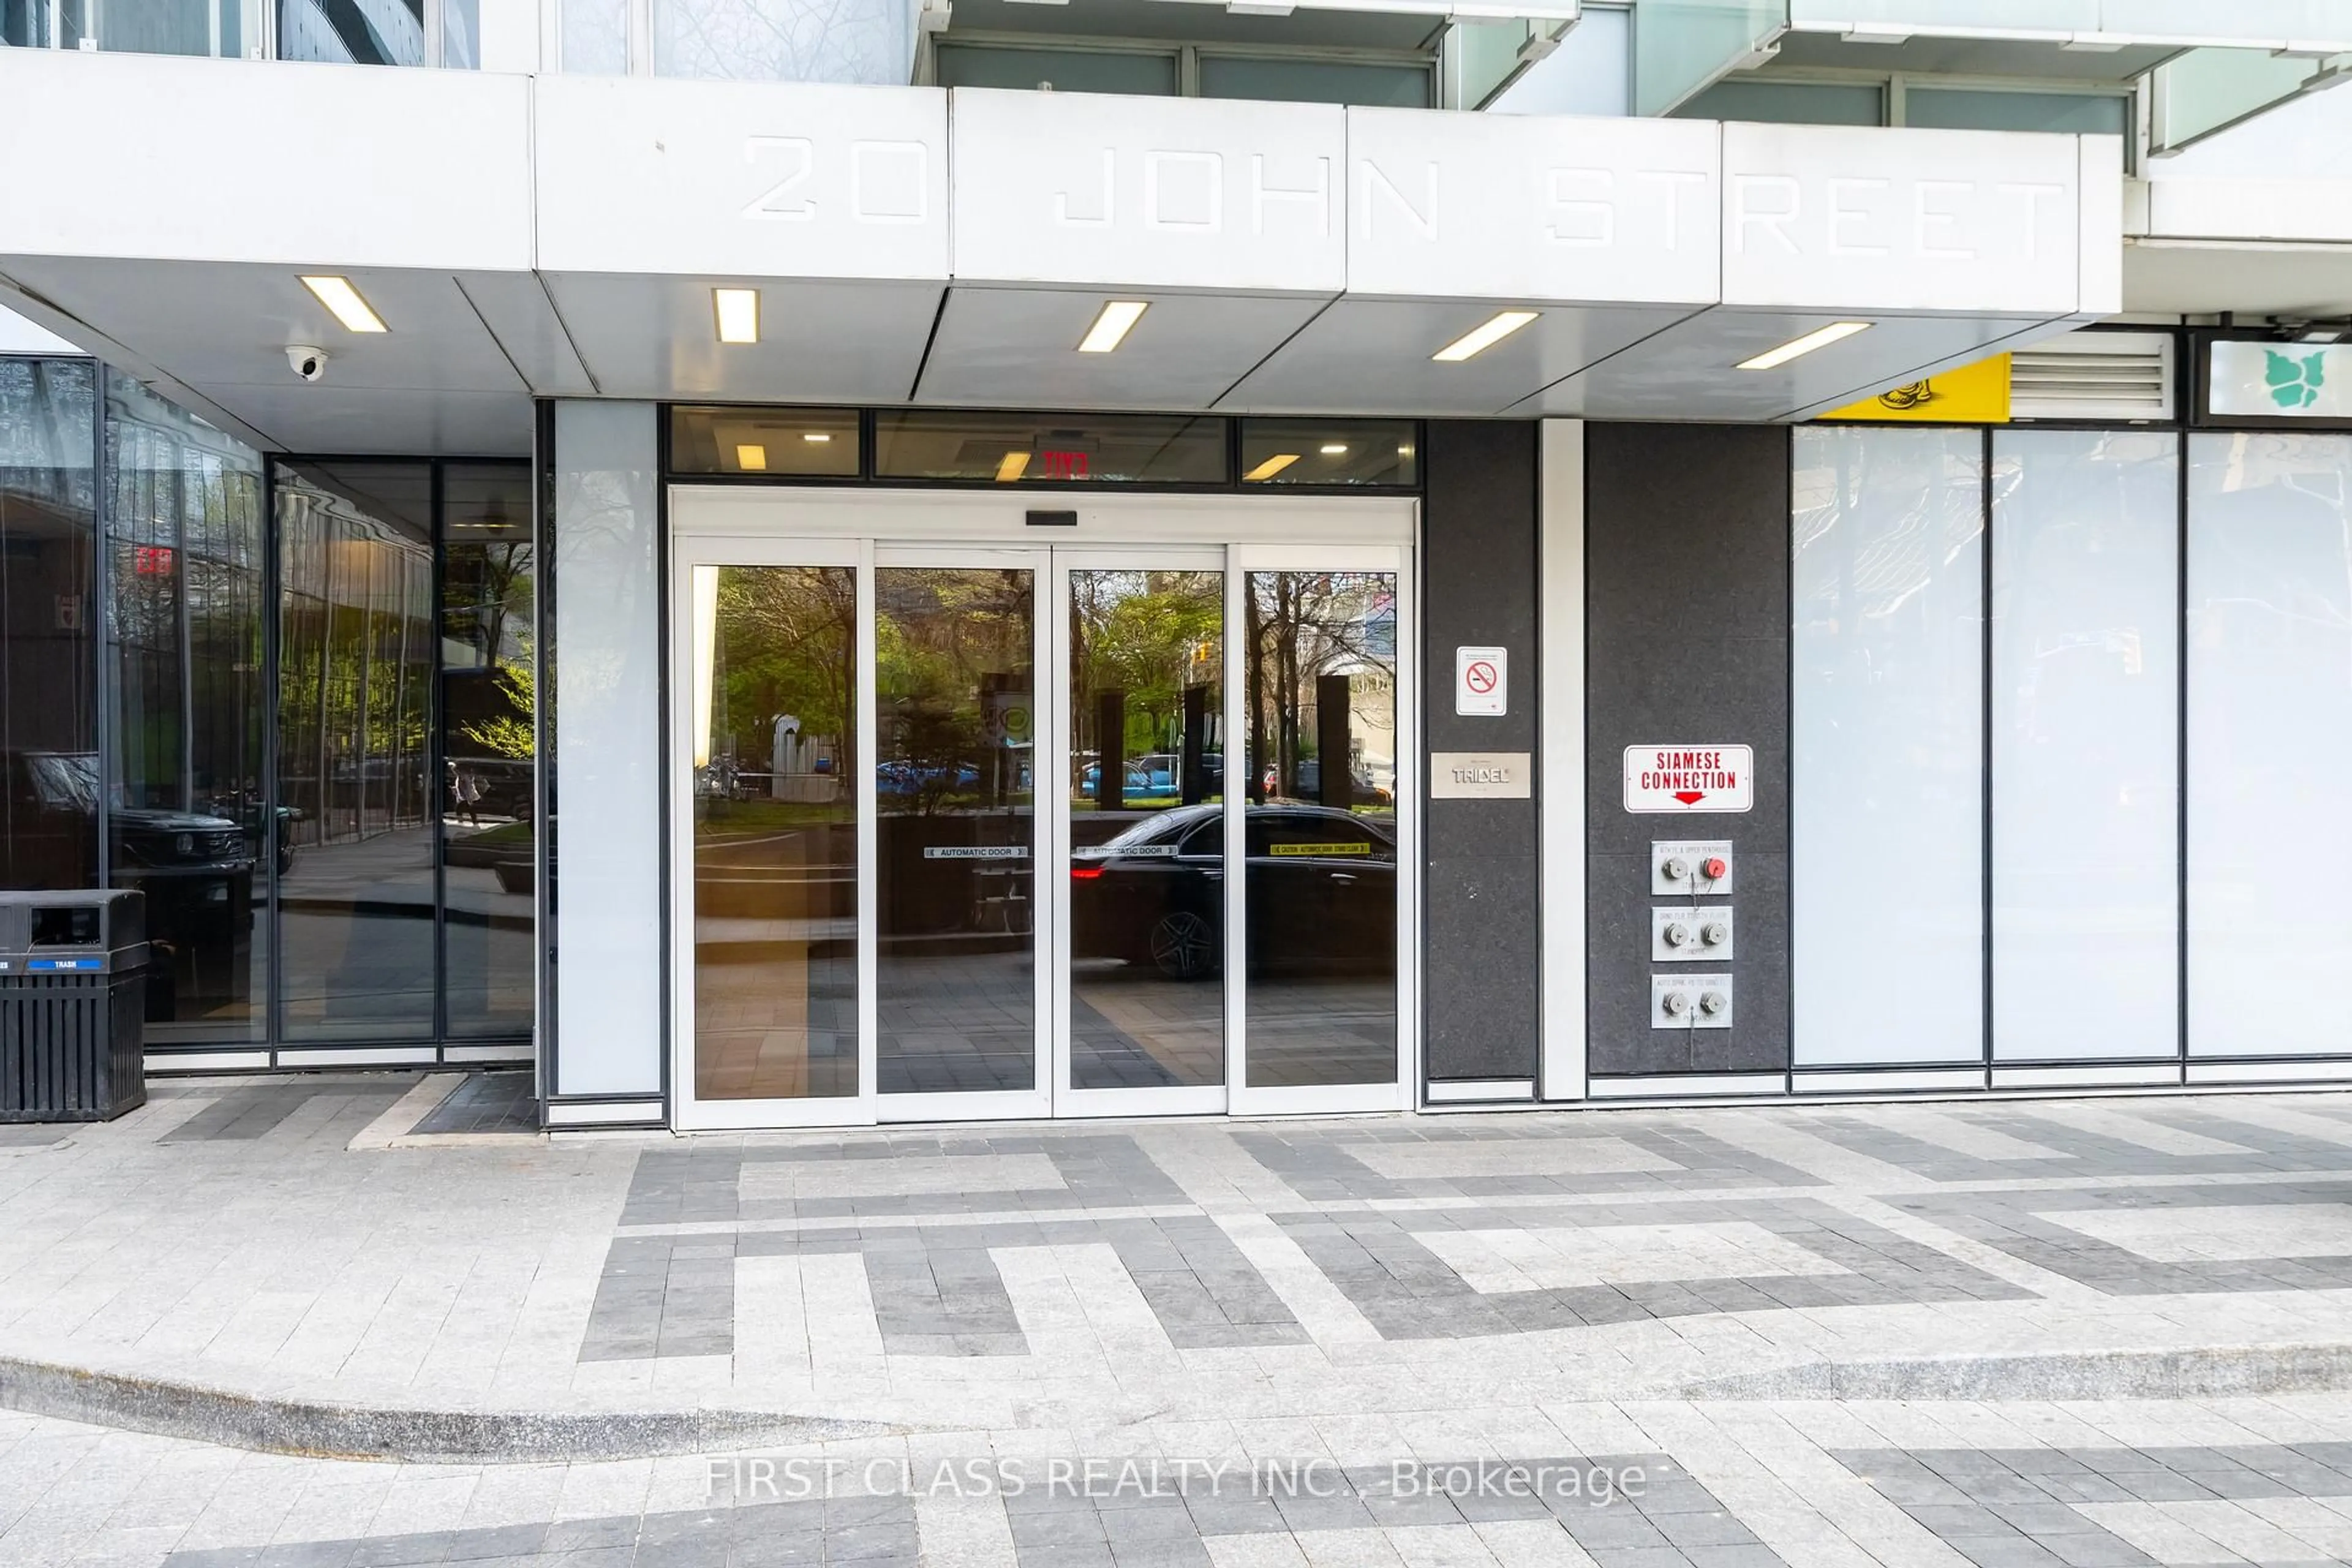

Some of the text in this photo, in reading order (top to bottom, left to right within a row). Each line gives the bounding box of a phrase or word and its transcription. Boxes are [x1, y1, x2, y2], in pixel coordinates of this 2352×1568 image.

[740, 135, 2066, 261] 20 JOHN STREET
[1657, 752, 1721, 770] SIAMESE
[1452, 767, 1510, 784] TRIDEL
[1641, 772, 1736, 790] CONNECTION
[55, 960, 77, 968] TRASH
